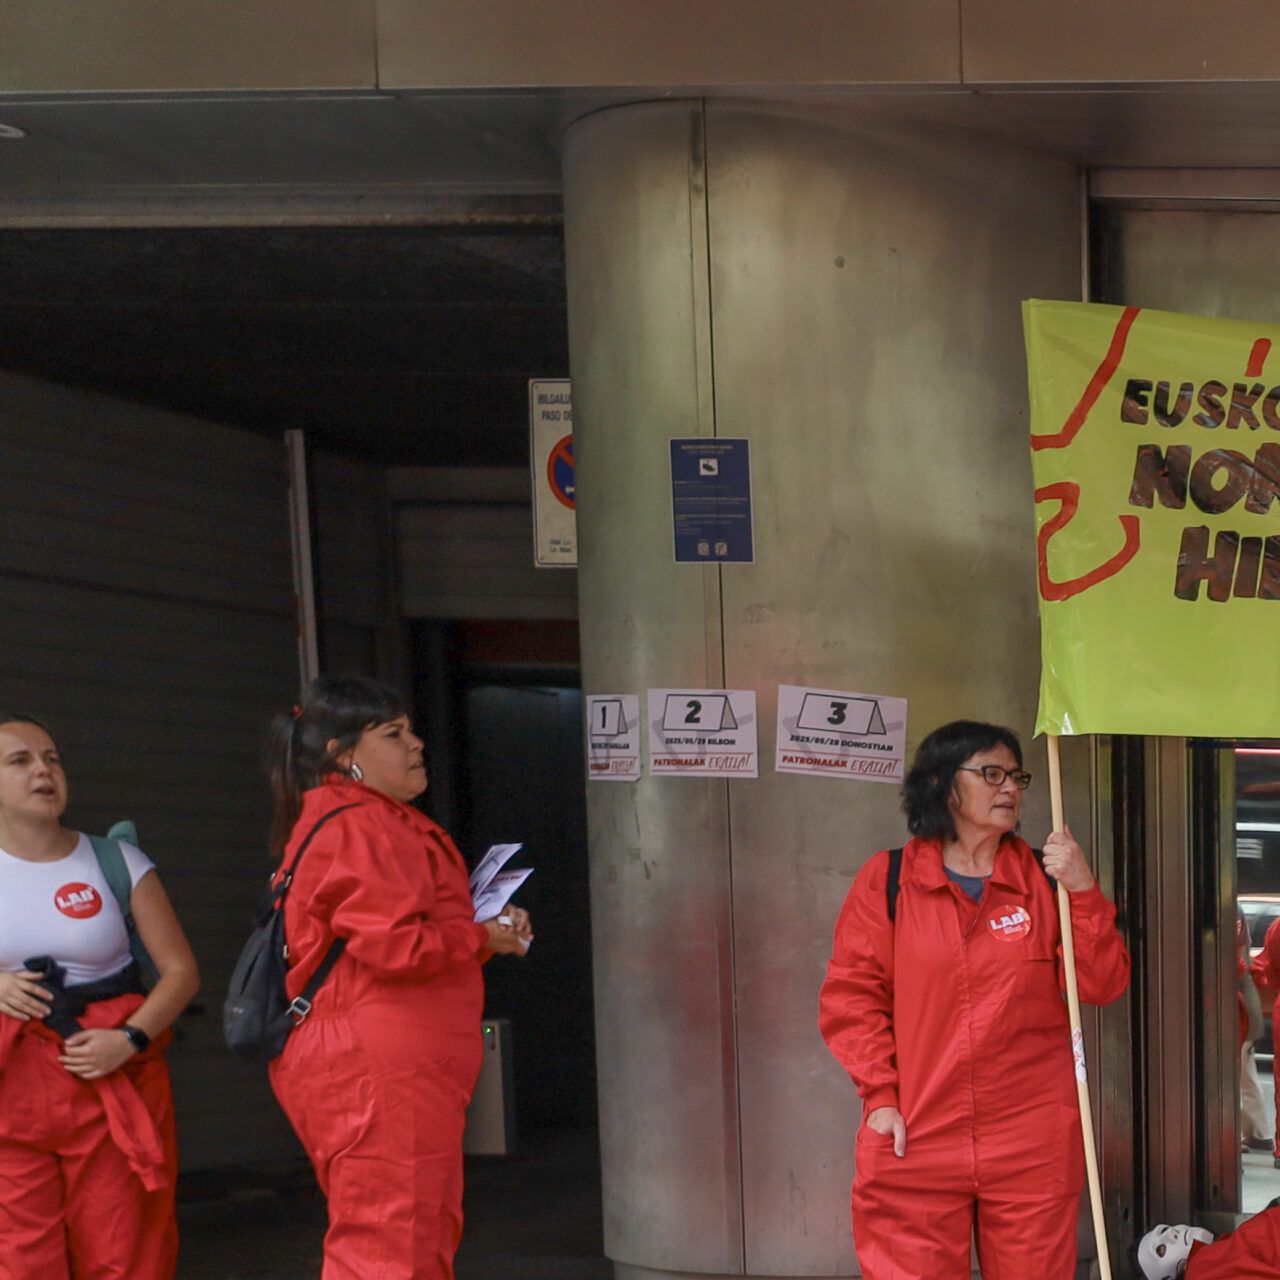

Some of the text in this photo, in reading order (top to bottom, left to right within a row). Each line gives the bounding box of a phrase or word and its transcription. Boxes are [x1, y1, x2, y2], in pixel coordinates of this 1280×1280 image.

[684, 700, 702, 724] 2
[827, 701, 849, 725] 3
[782, 755, 849, 768] PATRONALAK
